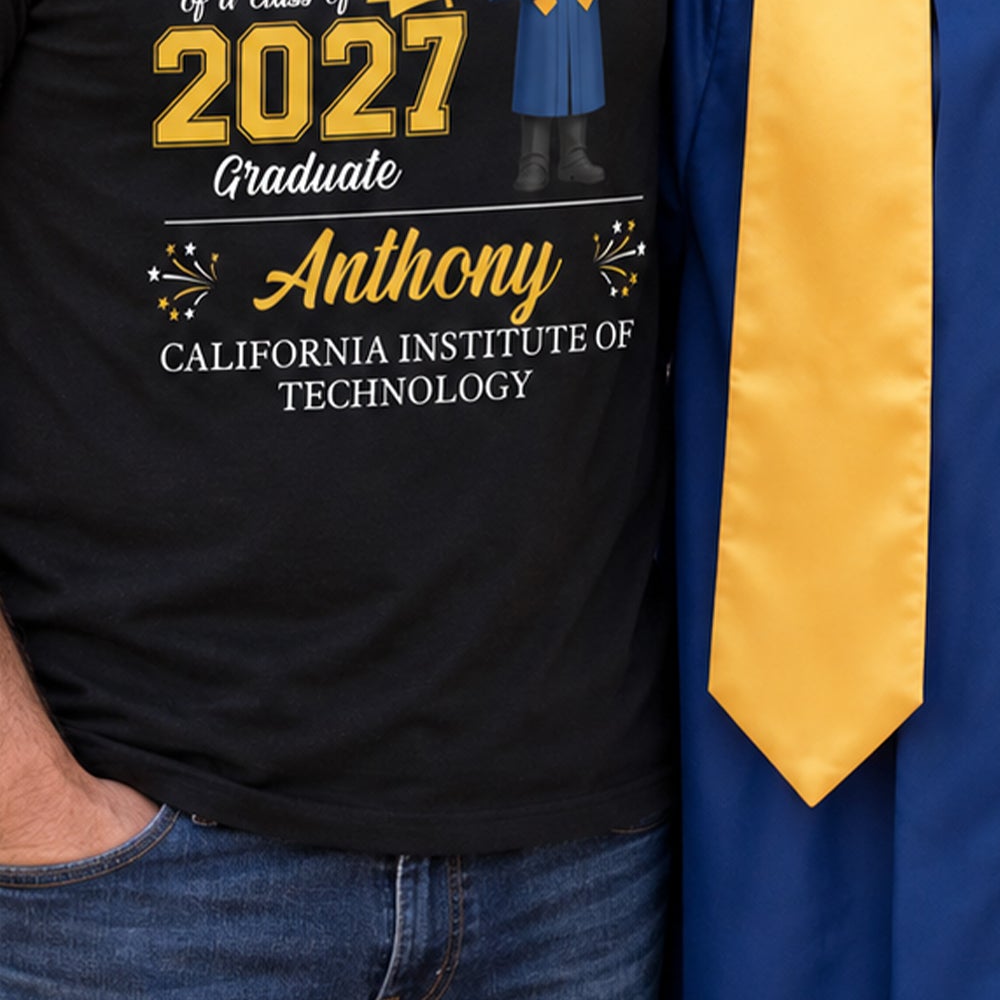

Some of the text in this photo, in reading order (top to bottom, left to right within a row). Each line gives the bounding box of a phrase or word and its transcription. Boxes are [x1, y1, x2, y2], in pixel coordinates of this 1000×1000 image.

[153, 11, 467, 148] 2027
[214, 149, 402, 200] Graduate
[253, 227, 562, 325] Anthony
[161, 320, 634, 372] CALIFORNIA INSTITUTE OF
[278, 370, 532, 411] TECHNOLOGY
